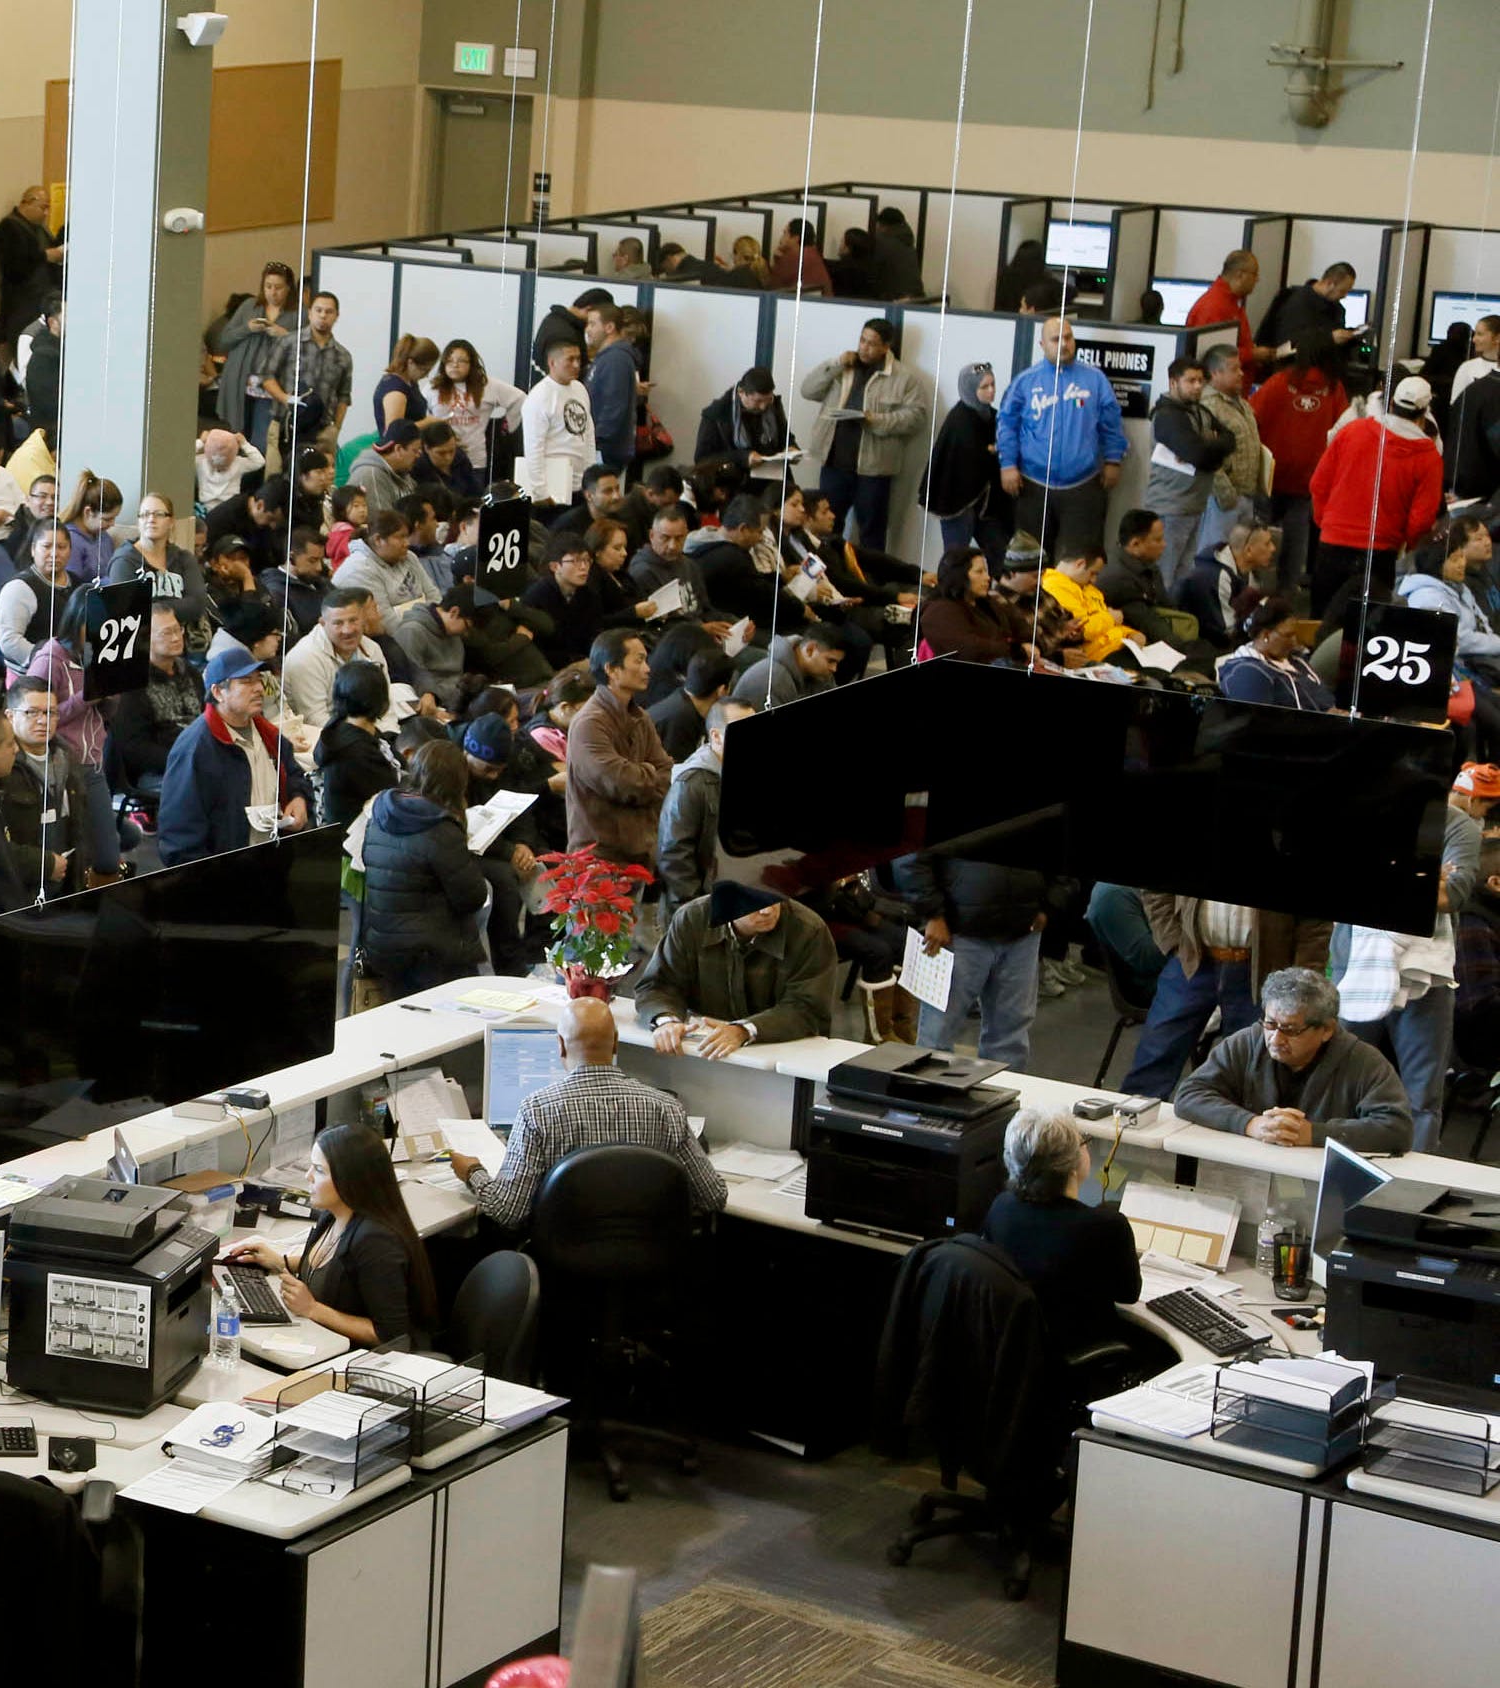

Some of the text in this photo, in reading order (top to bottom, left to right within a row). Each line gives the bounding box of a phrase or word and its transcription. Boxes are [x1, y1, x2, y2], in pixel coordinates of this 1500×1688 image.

[1076, 347, 1149, 372] CELL PHONES
[486, 528, 520, 574] 26
[97, 614, 142, 664] 27
[1362, 635, 1431, 685] 25
[136, 1303, 146, 1348] 2014
